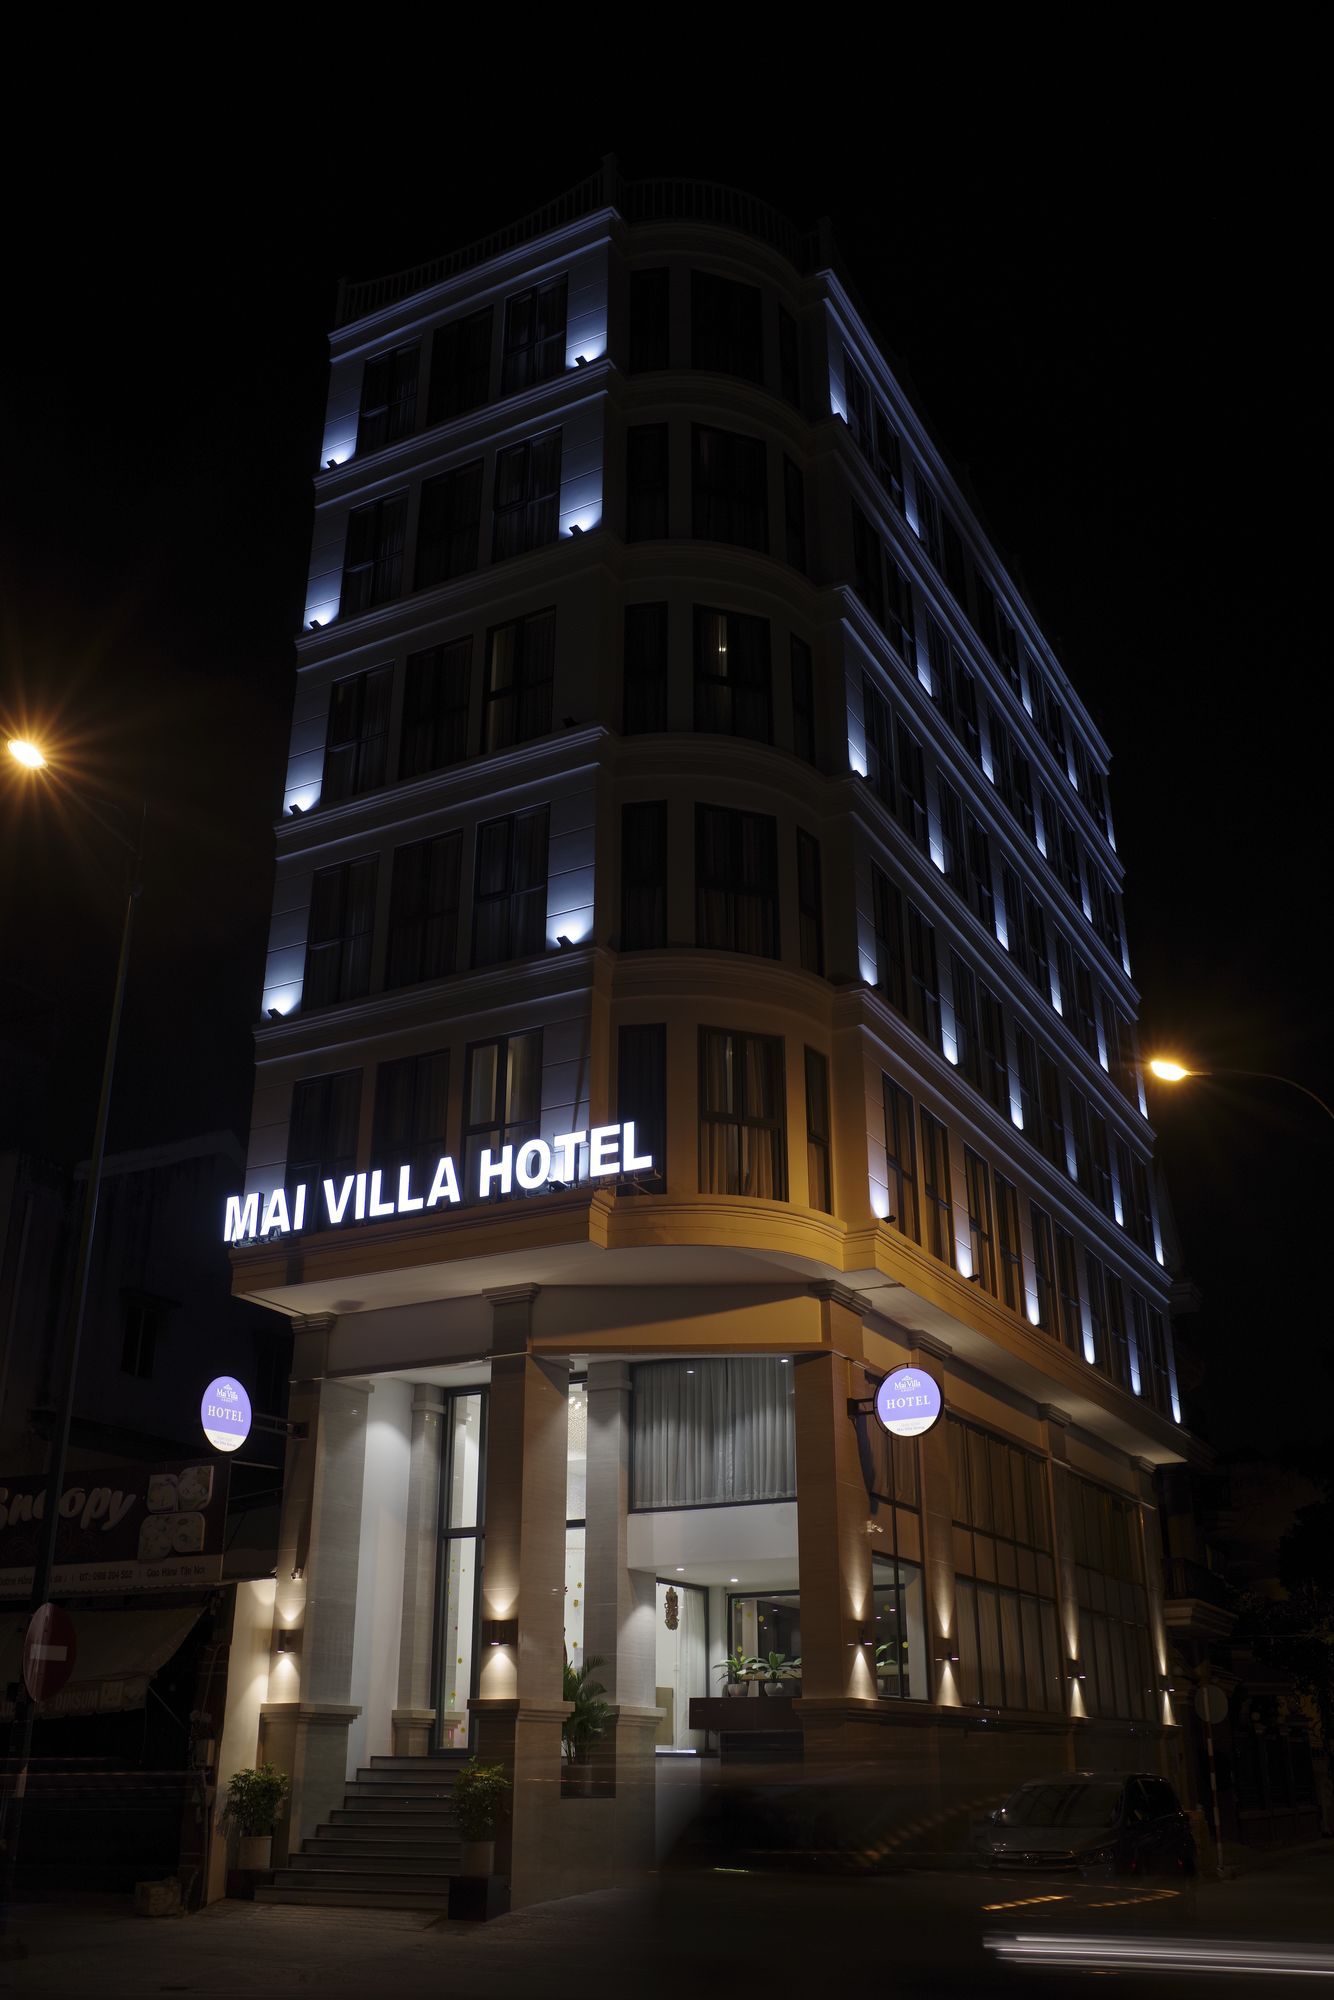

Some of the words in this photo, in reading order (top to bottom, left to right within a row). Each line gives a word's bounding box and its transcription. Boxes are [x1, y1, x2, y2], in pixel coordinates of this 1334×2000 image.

[223, 1184, 306, 1242] MAI
[323, 1156, 461, 1224] VILLA
[479, 1120, 653, 1198] HOTEL
[886, 1394, 931, 1410] HOTEL
[207, 1404, 244, 1423] HOTEL
